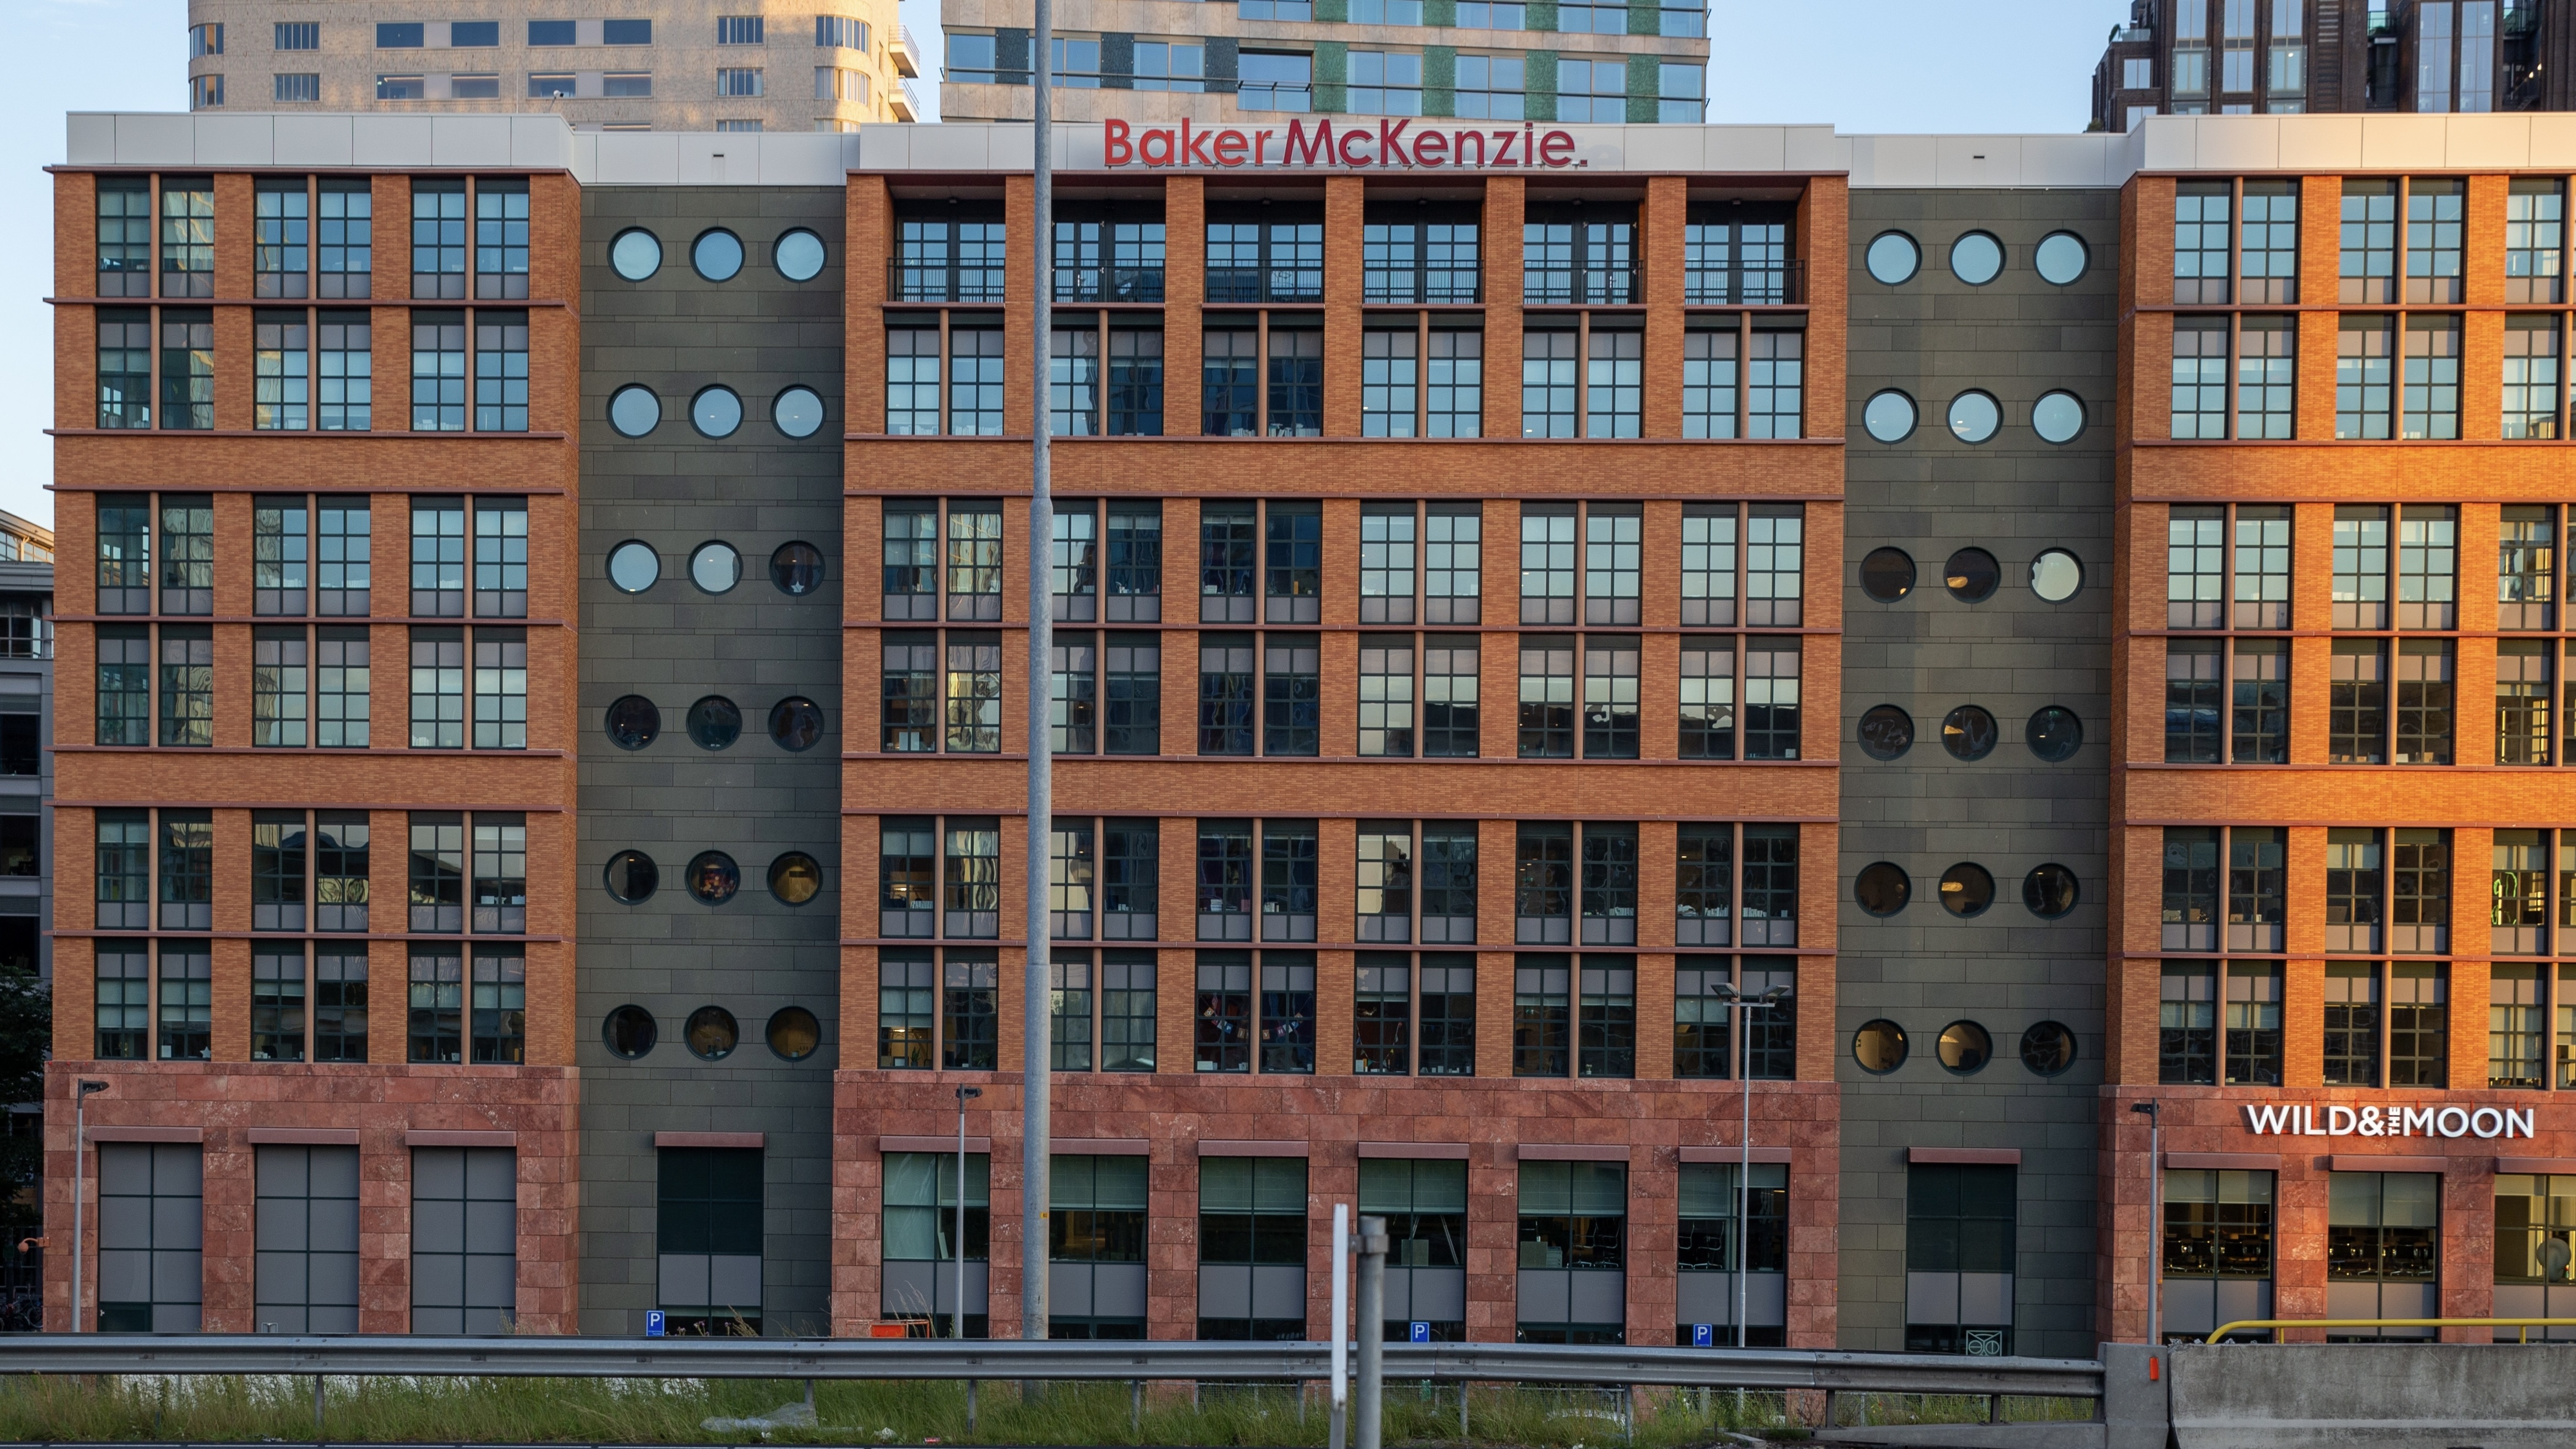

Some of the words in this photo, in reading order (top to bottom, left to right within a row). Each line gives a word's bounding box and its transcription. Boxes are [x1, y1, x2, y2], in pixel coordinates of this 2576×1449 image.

[2388, 1106, 2401, 1136] THE
[2403, 1106, 2534, 1138] MOON
[651, 1313, 660, 1327] P
[1415, 1324, 1425, 1338] P
[1698, 1327, 1707, 1340] P
